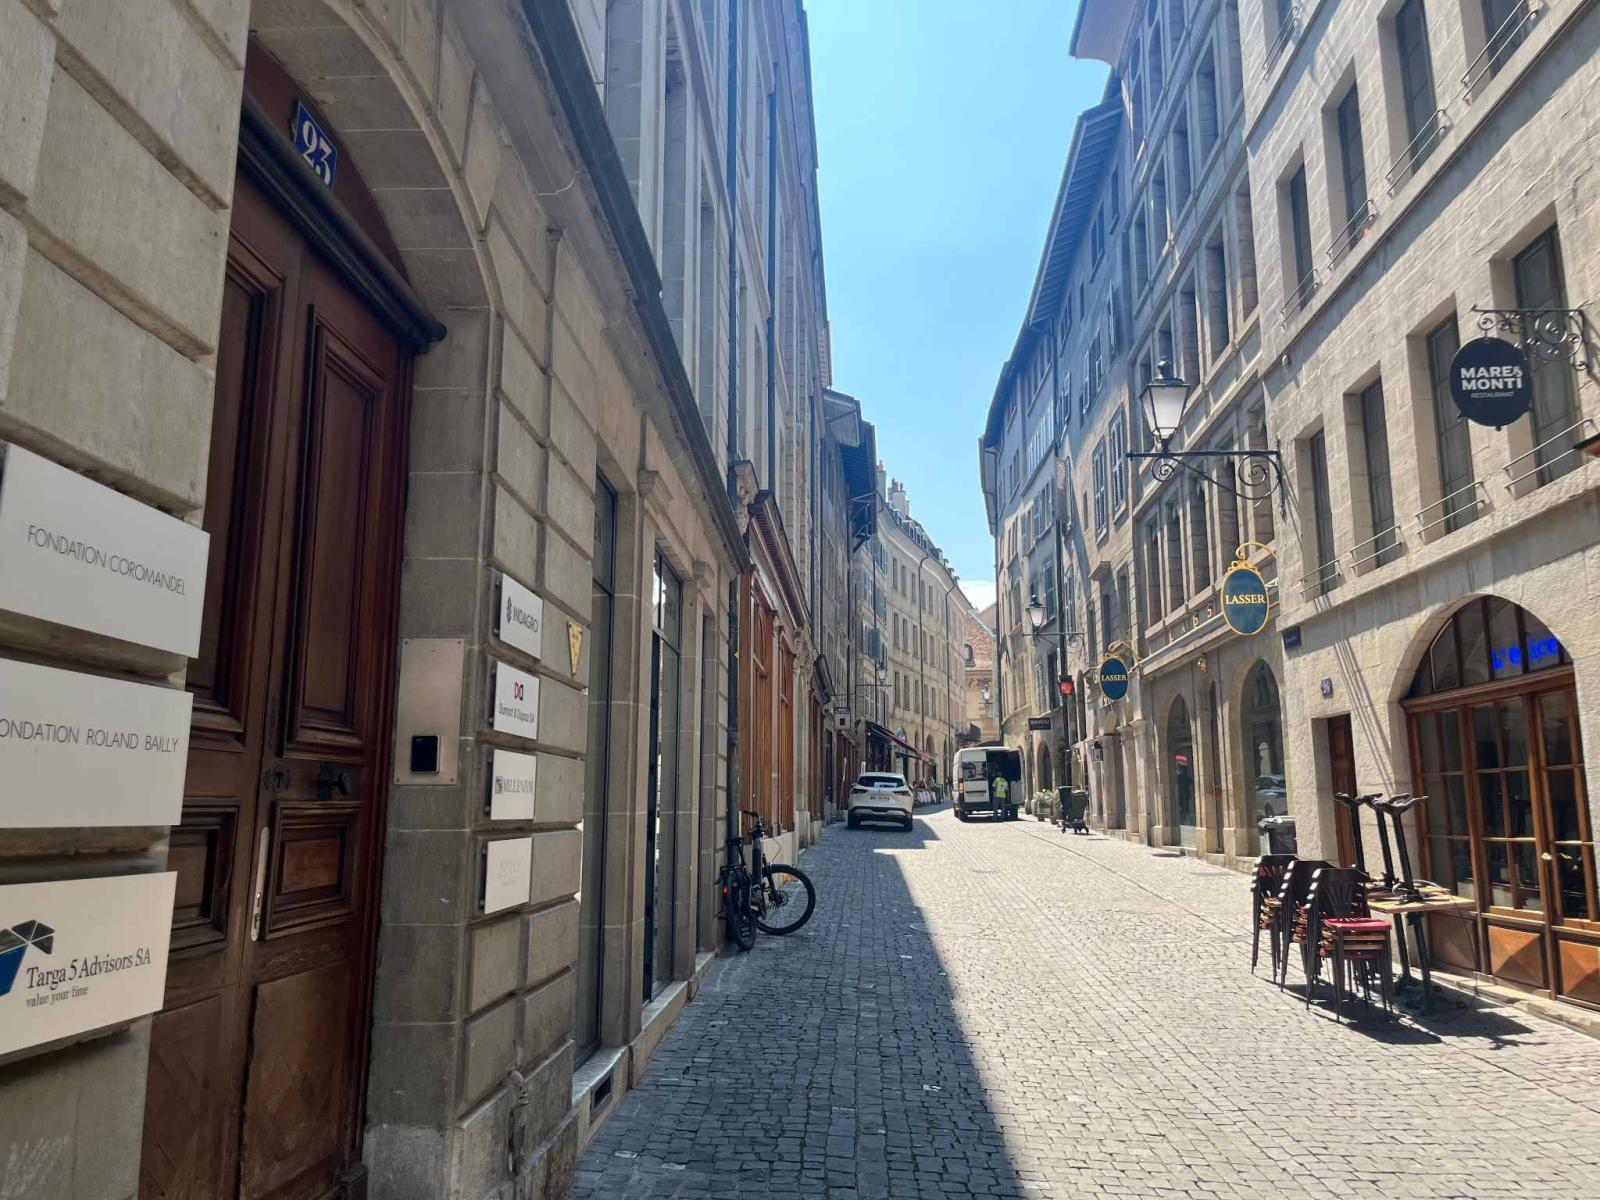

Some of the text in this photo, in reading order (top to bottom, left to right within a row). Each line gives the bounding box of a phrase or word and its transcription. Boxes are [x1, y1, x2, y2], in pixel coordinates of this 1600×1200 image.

[1462, 377, 1523, 391] MONTI
[27, 524, 186, 596] FONDATION COROMANDEL
[1225, 594, 1266, 605] LASSER
[513, 606, 539, 634] INDAGRO
[0, 718, 180, 753] ONDATION ROLAND BAILLY
[27, 947, 152, 990] Targa 5 Advisors SA
[26, 985, 89, 1008] value your time
